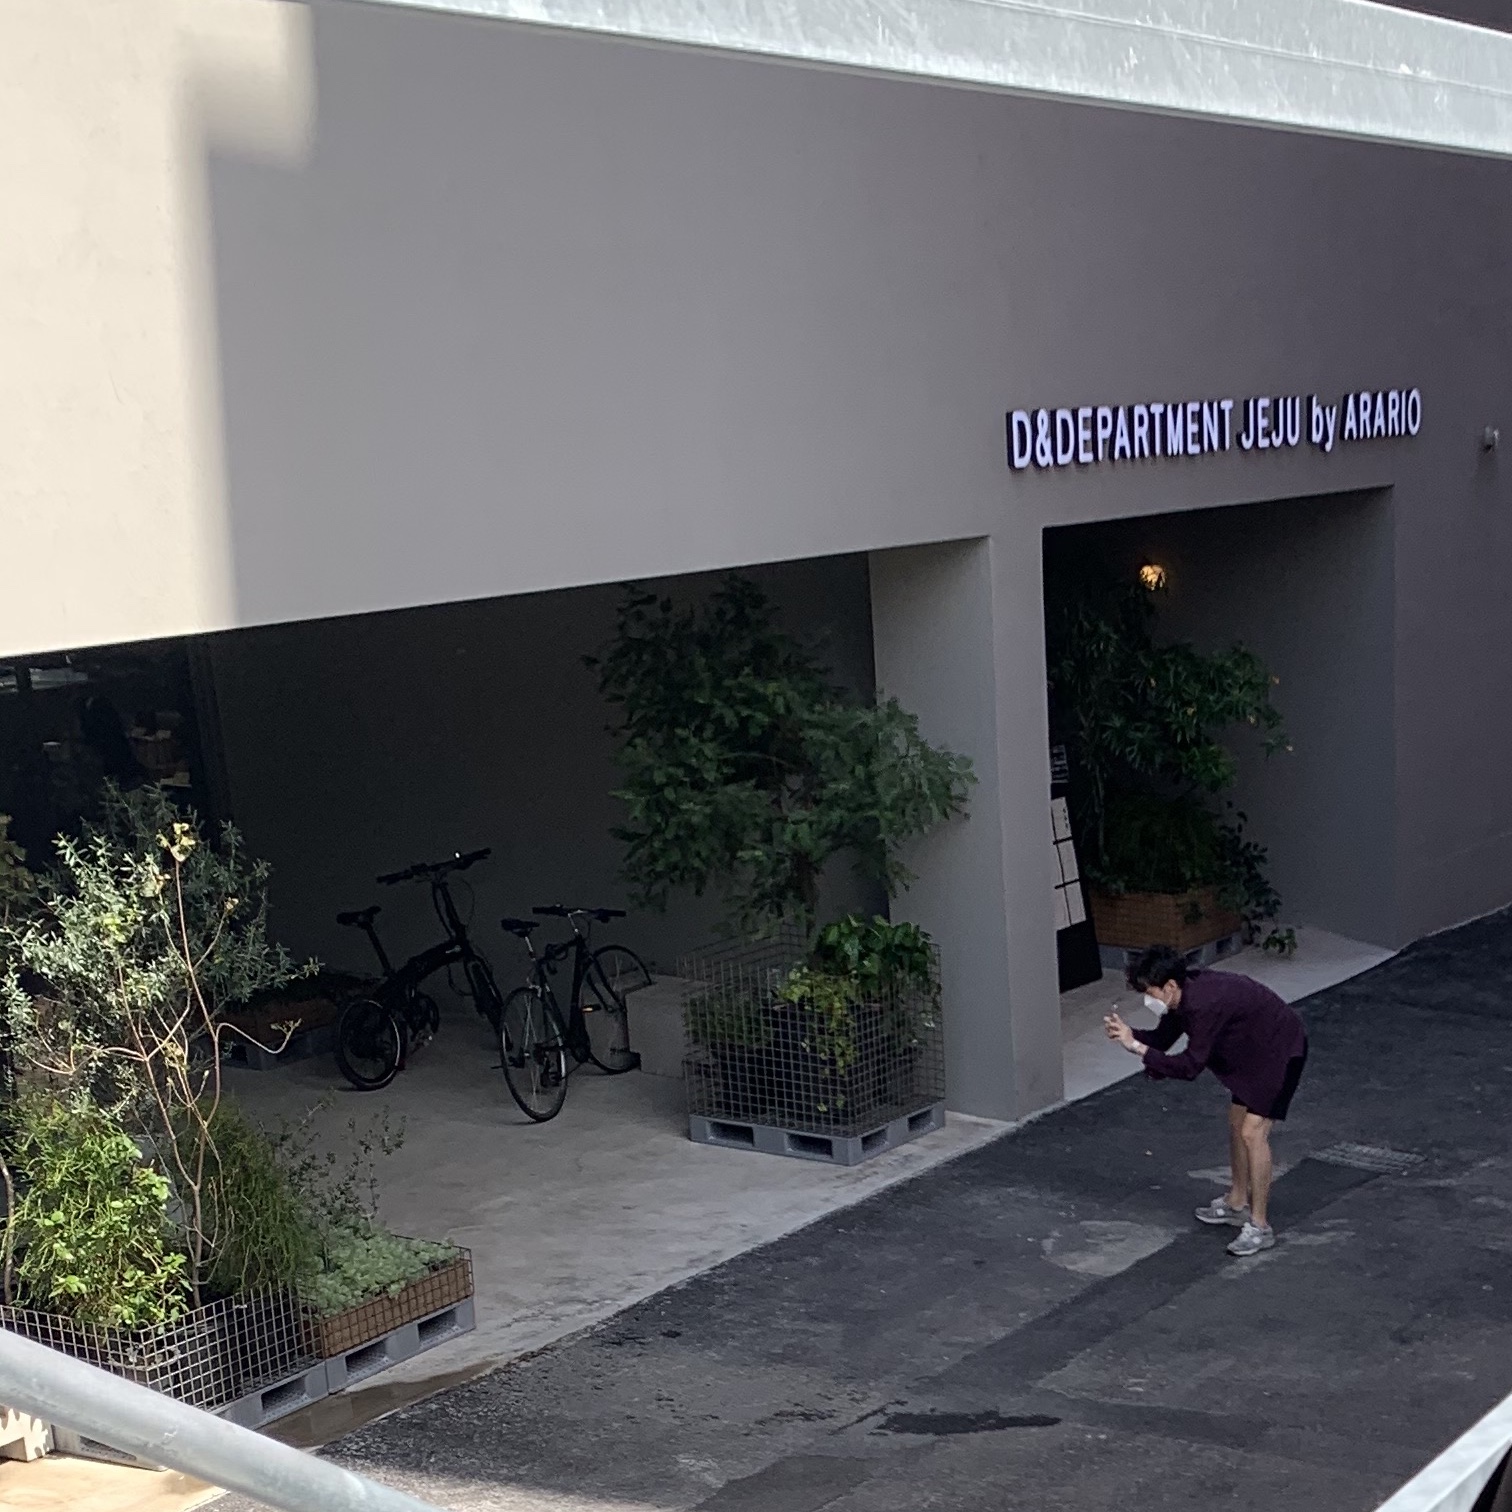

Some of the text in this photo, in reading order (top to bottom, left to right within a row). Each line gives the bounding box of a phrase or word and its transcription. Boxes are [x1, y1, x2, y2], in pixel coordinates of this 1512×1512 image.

[1008, 387, 1421, 469] D&DEPARTMENT JEJU by ARARIO
